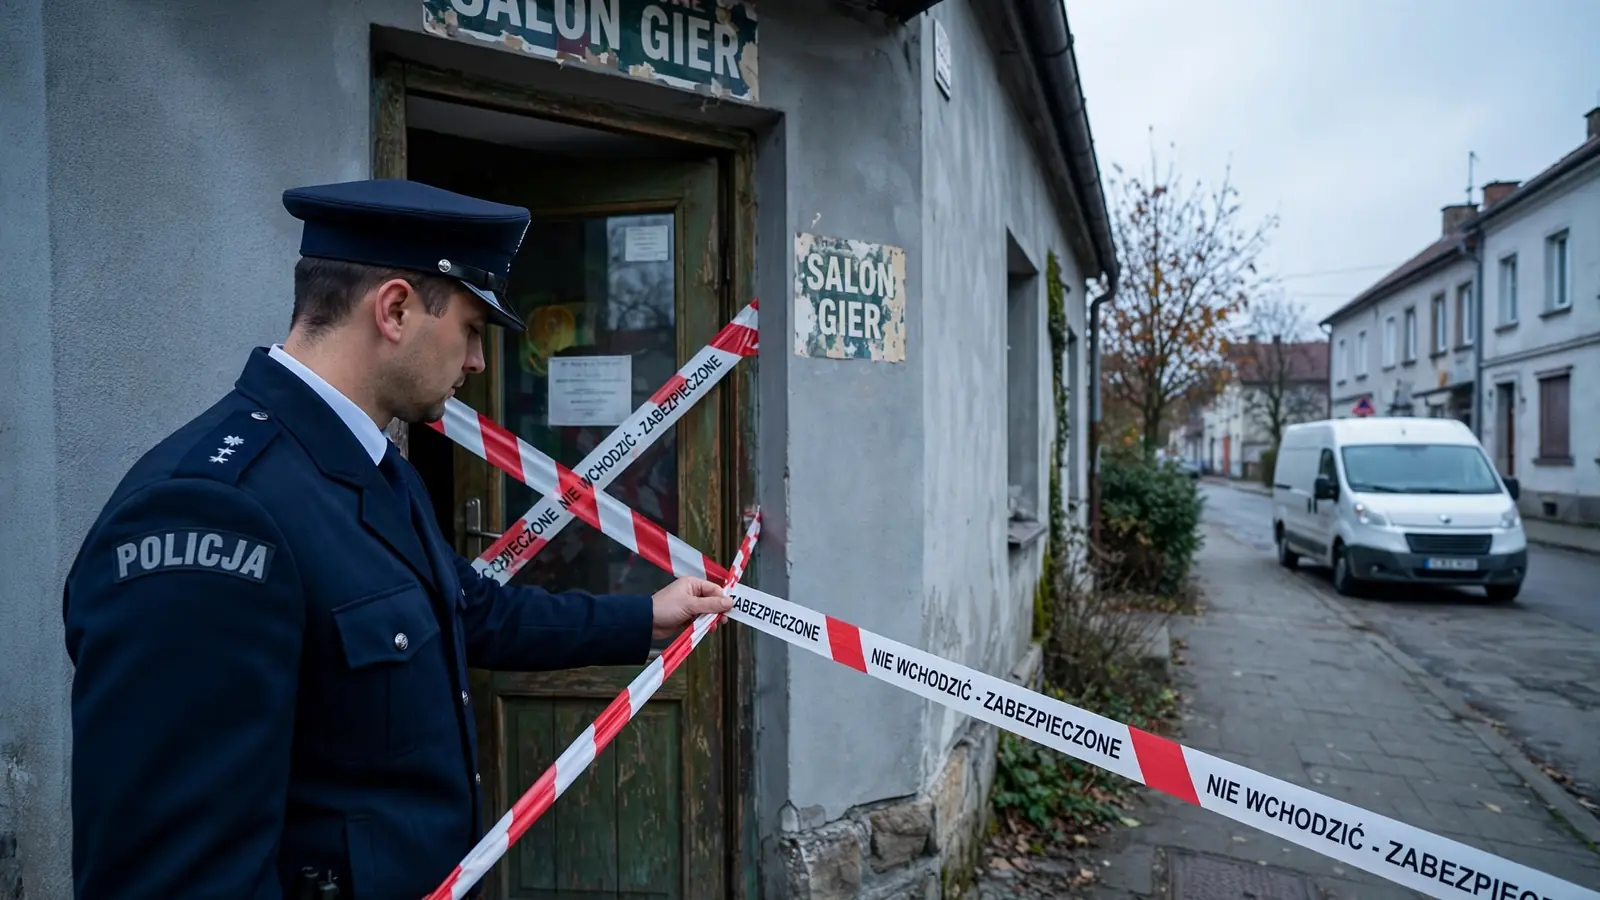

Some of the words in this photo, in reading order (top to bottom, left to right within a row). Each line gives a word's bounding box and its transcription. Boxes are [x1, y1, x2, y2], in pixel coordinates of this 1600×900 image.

[452, 0, 620, 50] LON
[641, 4, 740, 79] GIER
[806, 253, 894, 299] SALON
[818, 298, 882, 340] GIER
[557, 486, 582, 511] NIE
[639, 354, 723, 436] ZABEZPIECZONE
[116, 532, 268, 580] POLICJA
[871, 647, 894, 671] NIE
[896, 656, 972, 701] WCHODZIĆ
[983, 690, 1122, 760] ZABEZPIECZONE
[1206, 773, 1241, 804] NIE
[1246, 787, 1365, 850] WCHODZIĆ
[1385, 840, 1553, 900] ZABEZPIE
